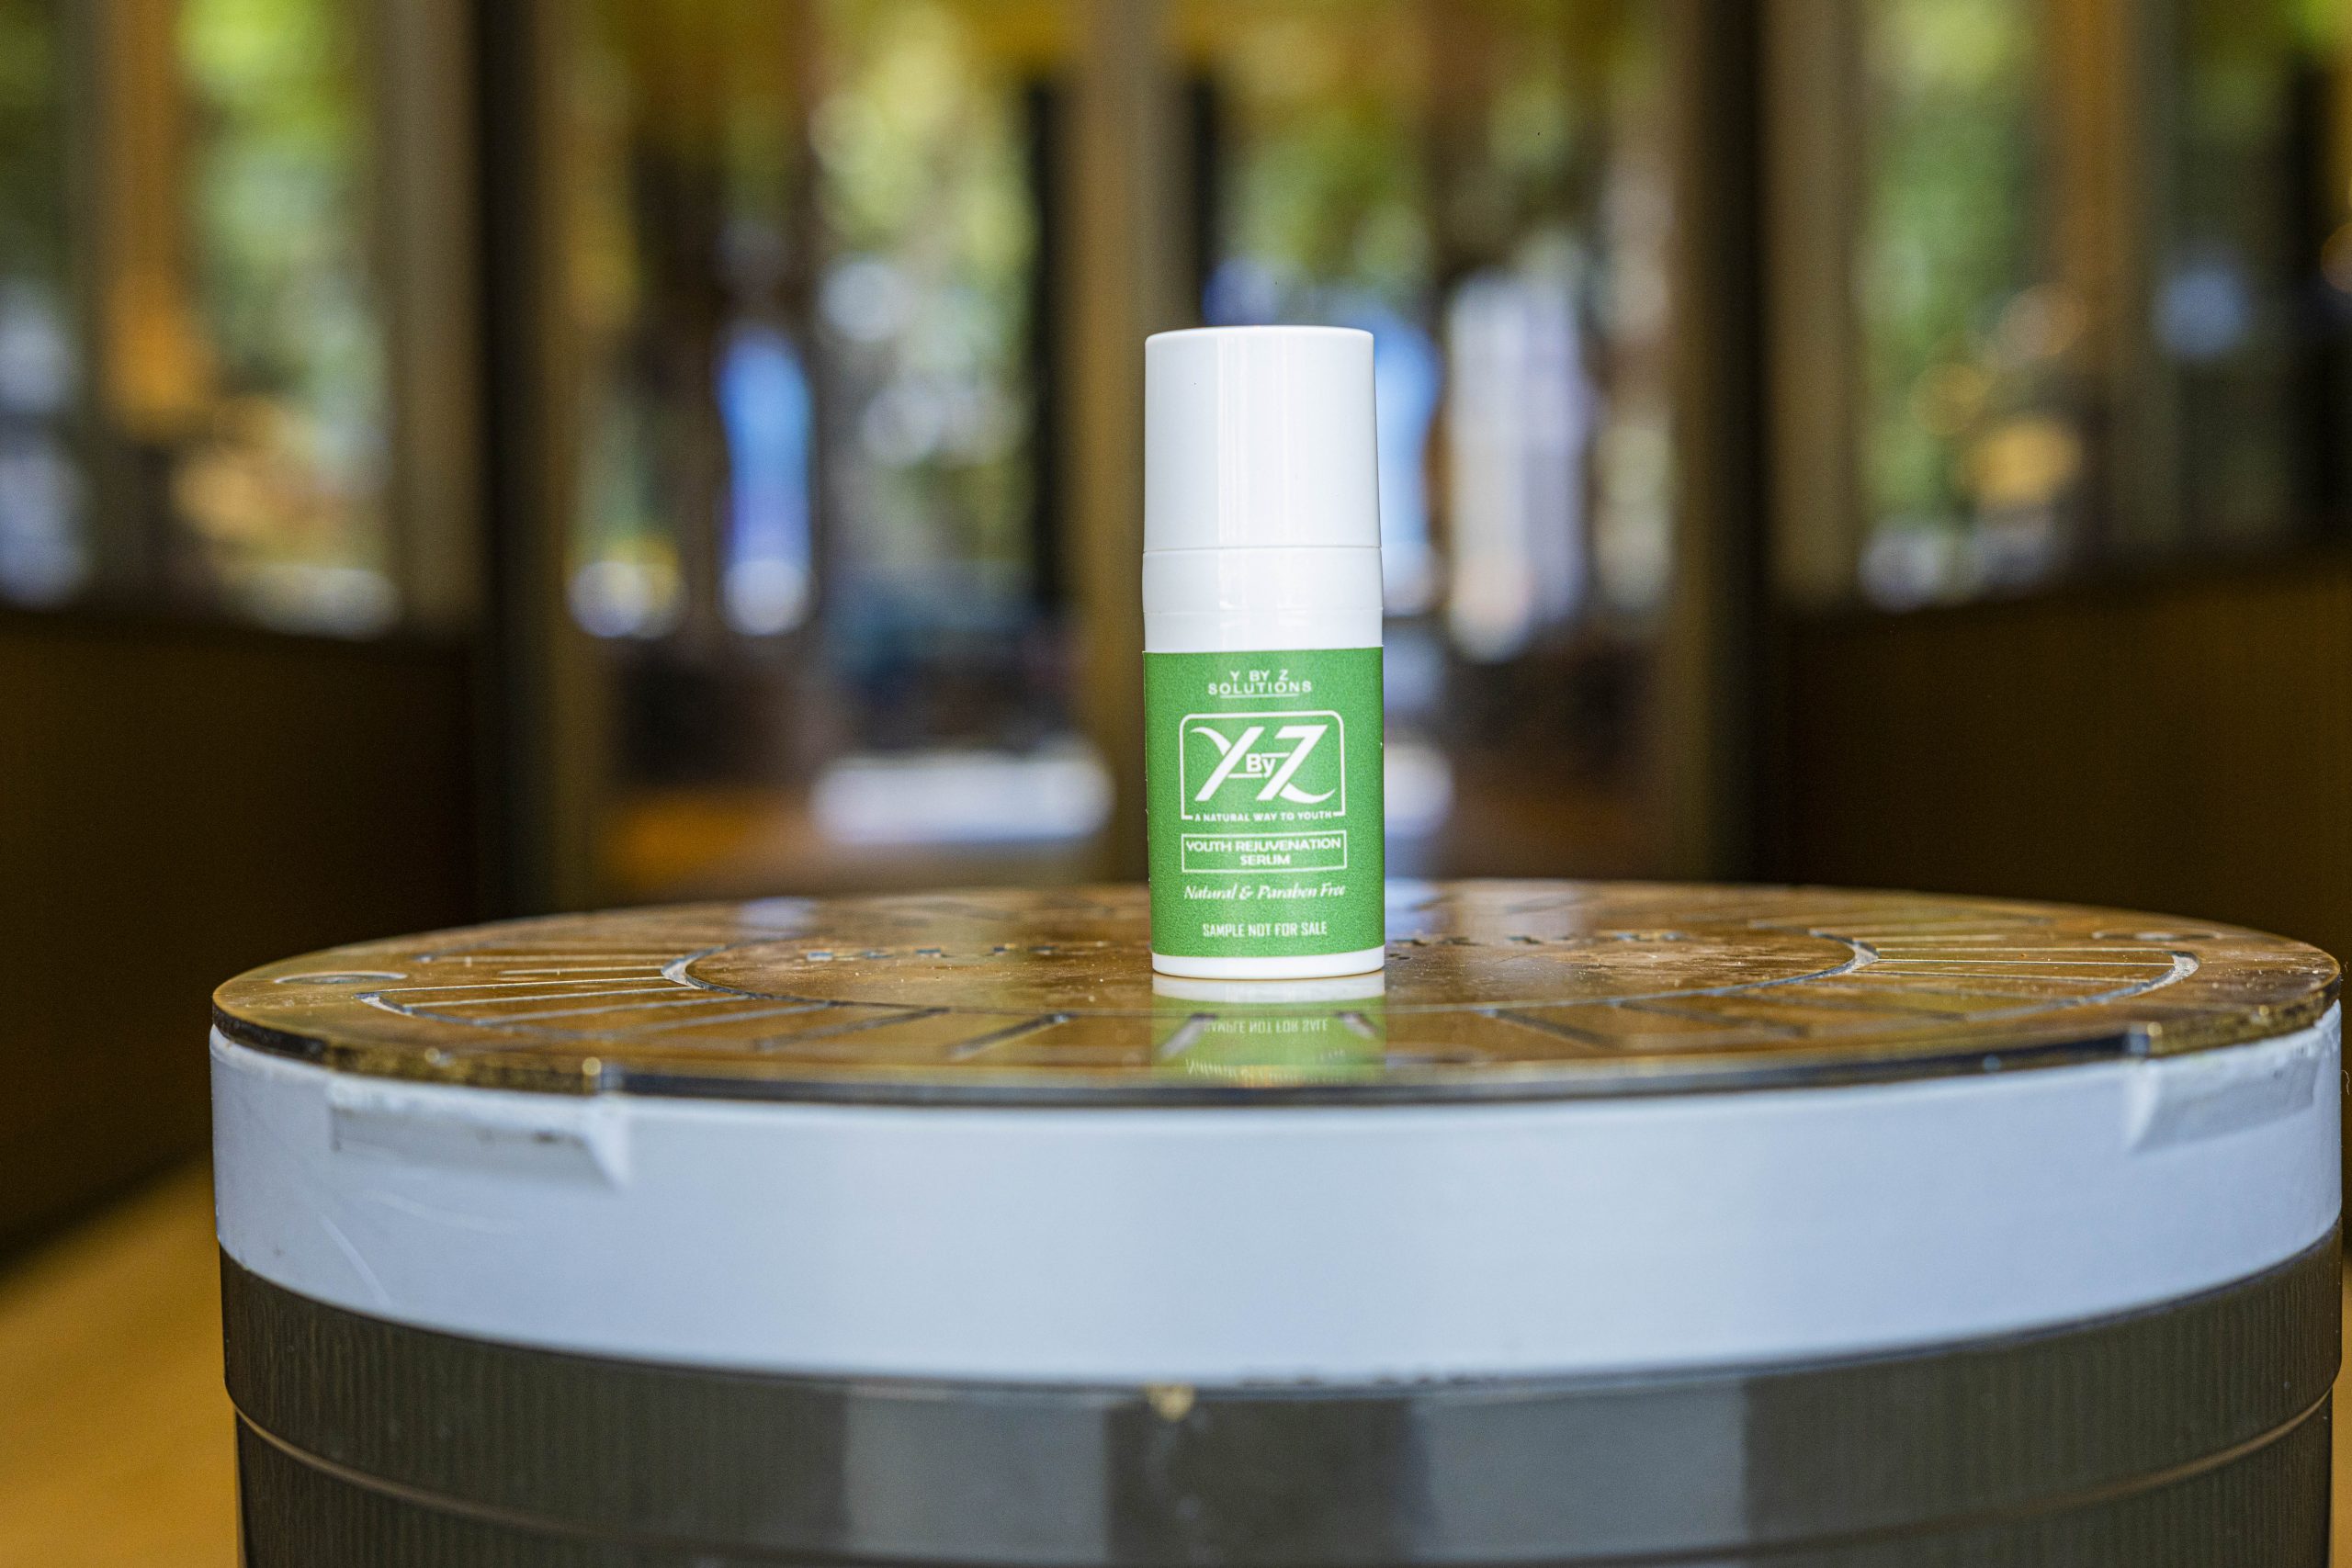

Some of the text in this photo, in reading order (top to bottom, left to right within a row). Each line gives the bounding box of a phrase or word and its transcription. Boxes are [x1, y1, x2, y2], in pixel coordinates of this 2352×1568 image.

[1230, 670, 1288, 682] Y BY Z
[1208, 681, 1312, 695] SOLUTIONS
[1190, 724, 1336, 805] Y By Z
[1194, 810, 1332, 822] A NATURAL WAY TO YOUTH
[1186, 838, 1341, 852] YOUTH REJUVENATION
[1239, 853, 1290, 866] SERUM
[1184, 882, 1346, 900] Natural & Paraben Free
[1203, 921, 1327, 938] SAMPLE NOT FOR SALE
